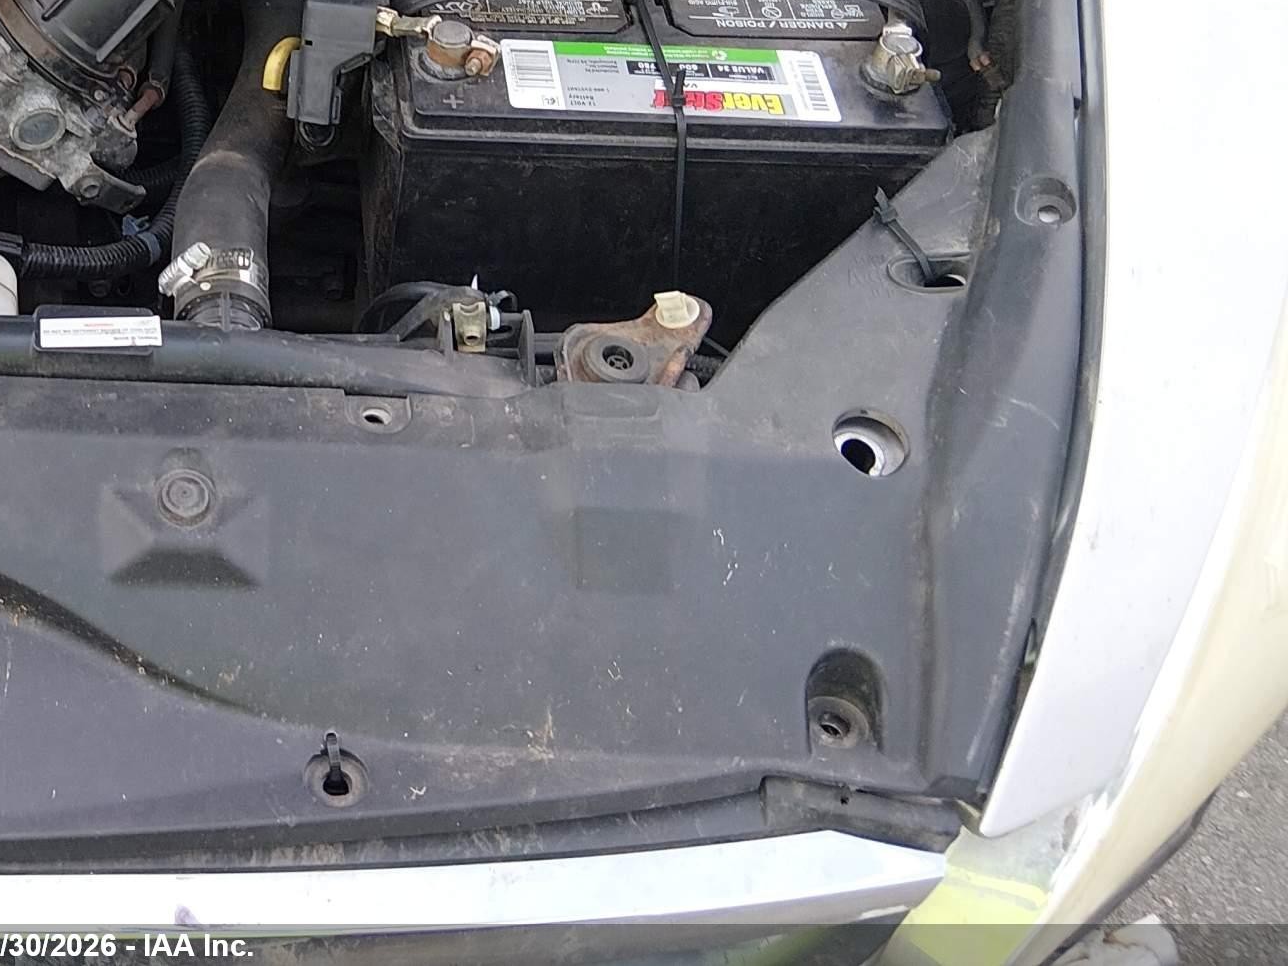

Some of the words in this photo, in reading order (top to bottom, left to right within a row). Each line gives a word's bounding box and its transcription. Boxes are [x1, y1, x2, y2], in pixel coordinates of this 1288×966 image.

[716, 18, 765, 29] POISON
[779, 20, 834, 29] DANGER
[653, 89, 786, 115] EverStat
